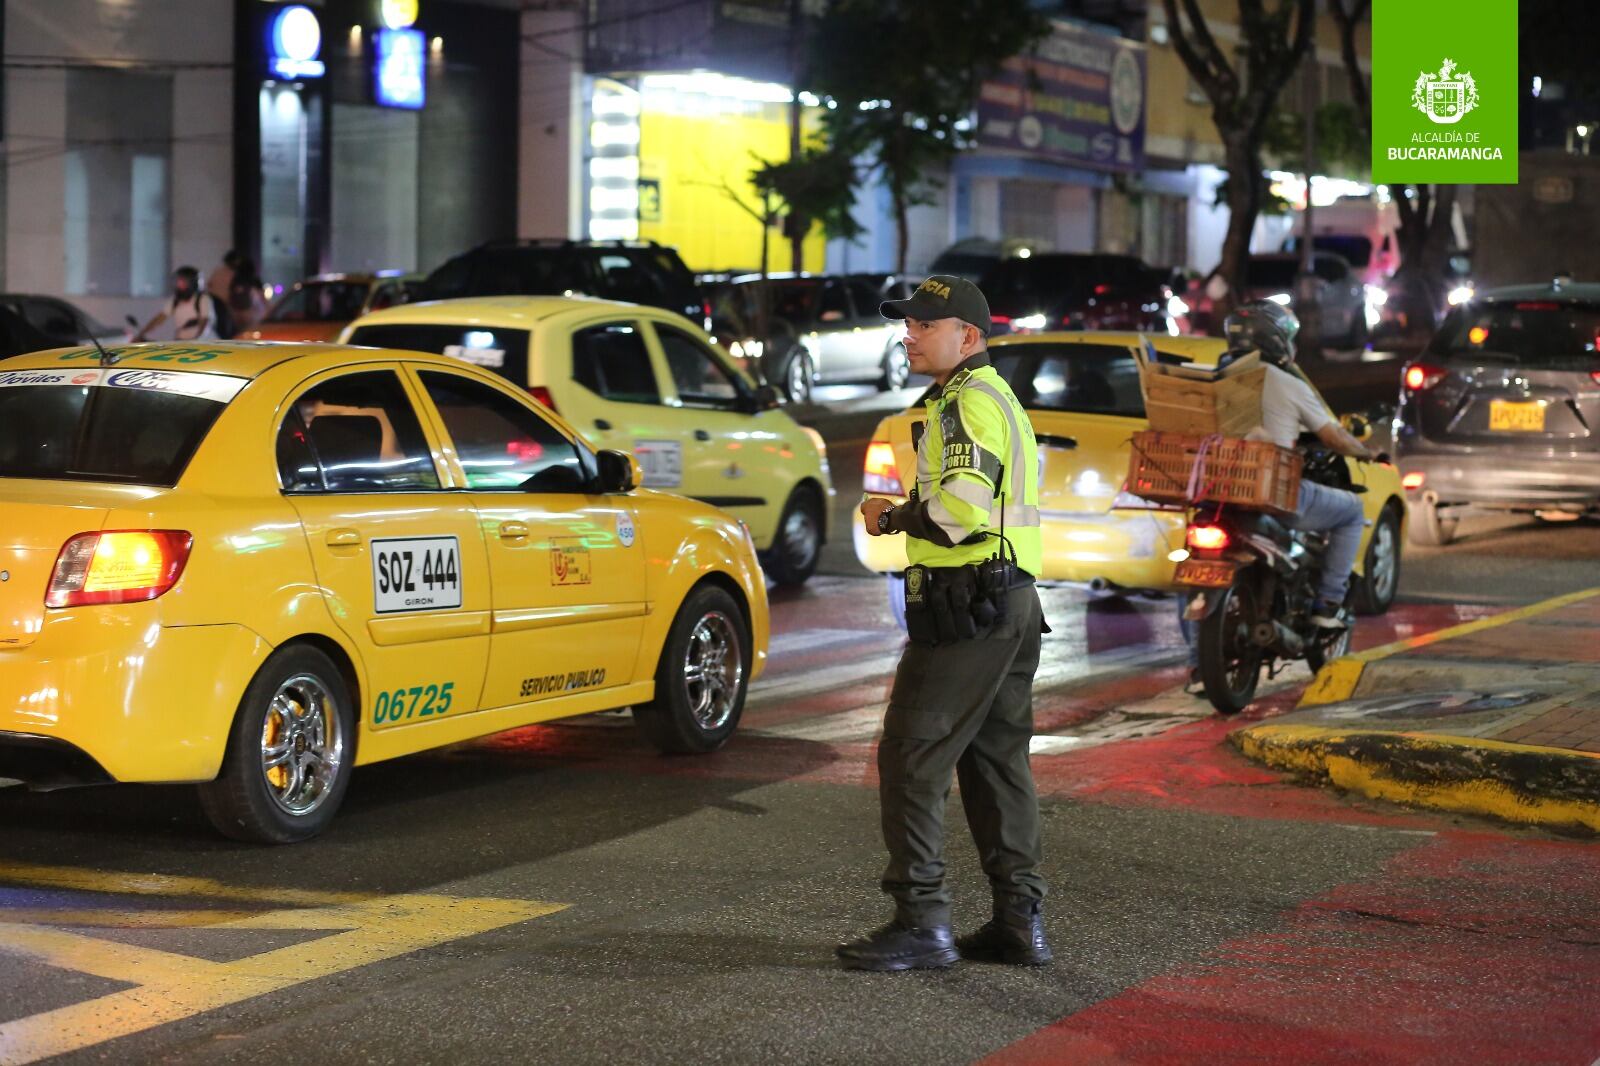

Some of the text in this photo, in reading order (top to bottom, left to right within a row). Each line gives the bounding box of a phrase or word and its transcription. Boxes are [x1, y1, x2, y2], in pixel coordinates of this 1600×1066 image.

[964, 443, 972, 455] Y
[378, 548, 457, 594] SOZ 444
[405, 598, 434, 606] GIRON
[519, 668, 606, 697] SERVICIO PUBLICO
[374, 682, 455, 725] 06725
